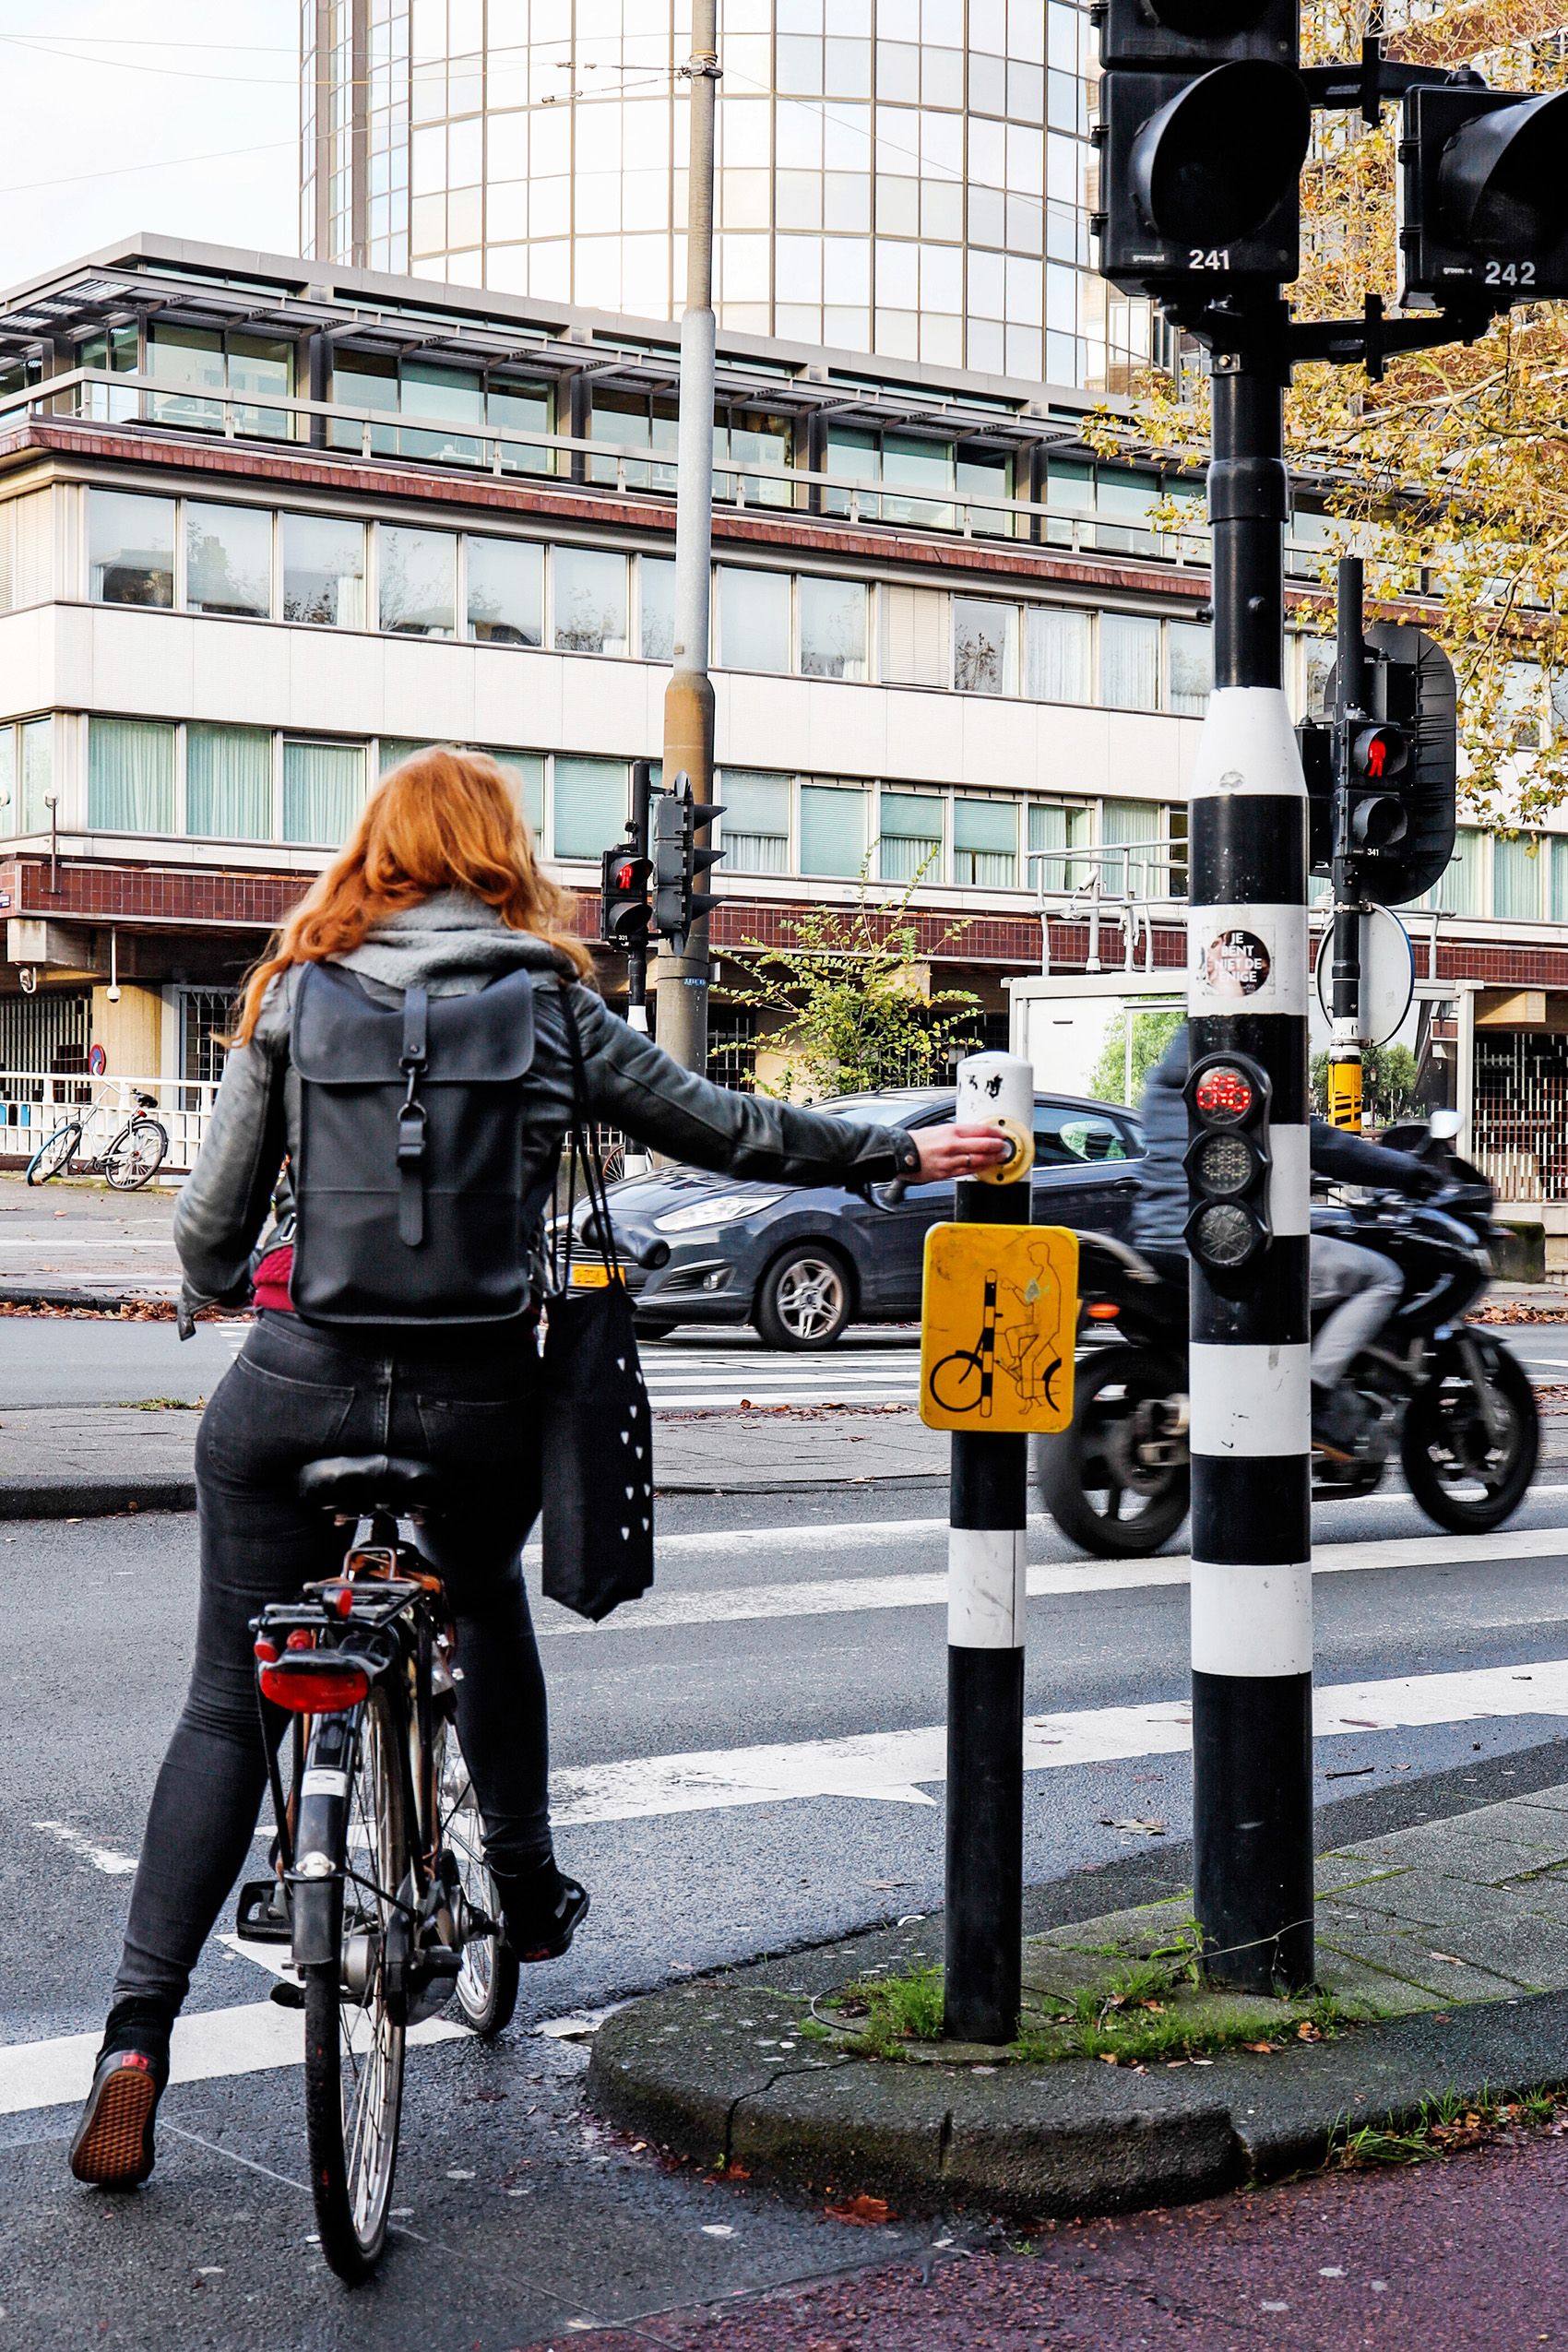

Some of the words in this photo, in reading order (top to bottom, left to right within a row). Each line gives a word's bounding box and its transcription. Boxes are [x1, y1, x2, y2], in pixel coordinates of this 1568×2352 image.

[1189, 249, 1229, 270] 241
[1485, 261, 1536, 286] 242
[1367, 848, 1380, 856] 341
[1229, 932, 1244, 945] JE
[1221, 945, 1254, 957] BENT
[1214, 957, 1241, 970] NIET
[1245, 957, 1263, 970] DE
[1219, 971, 1258, 983] ENIGE
